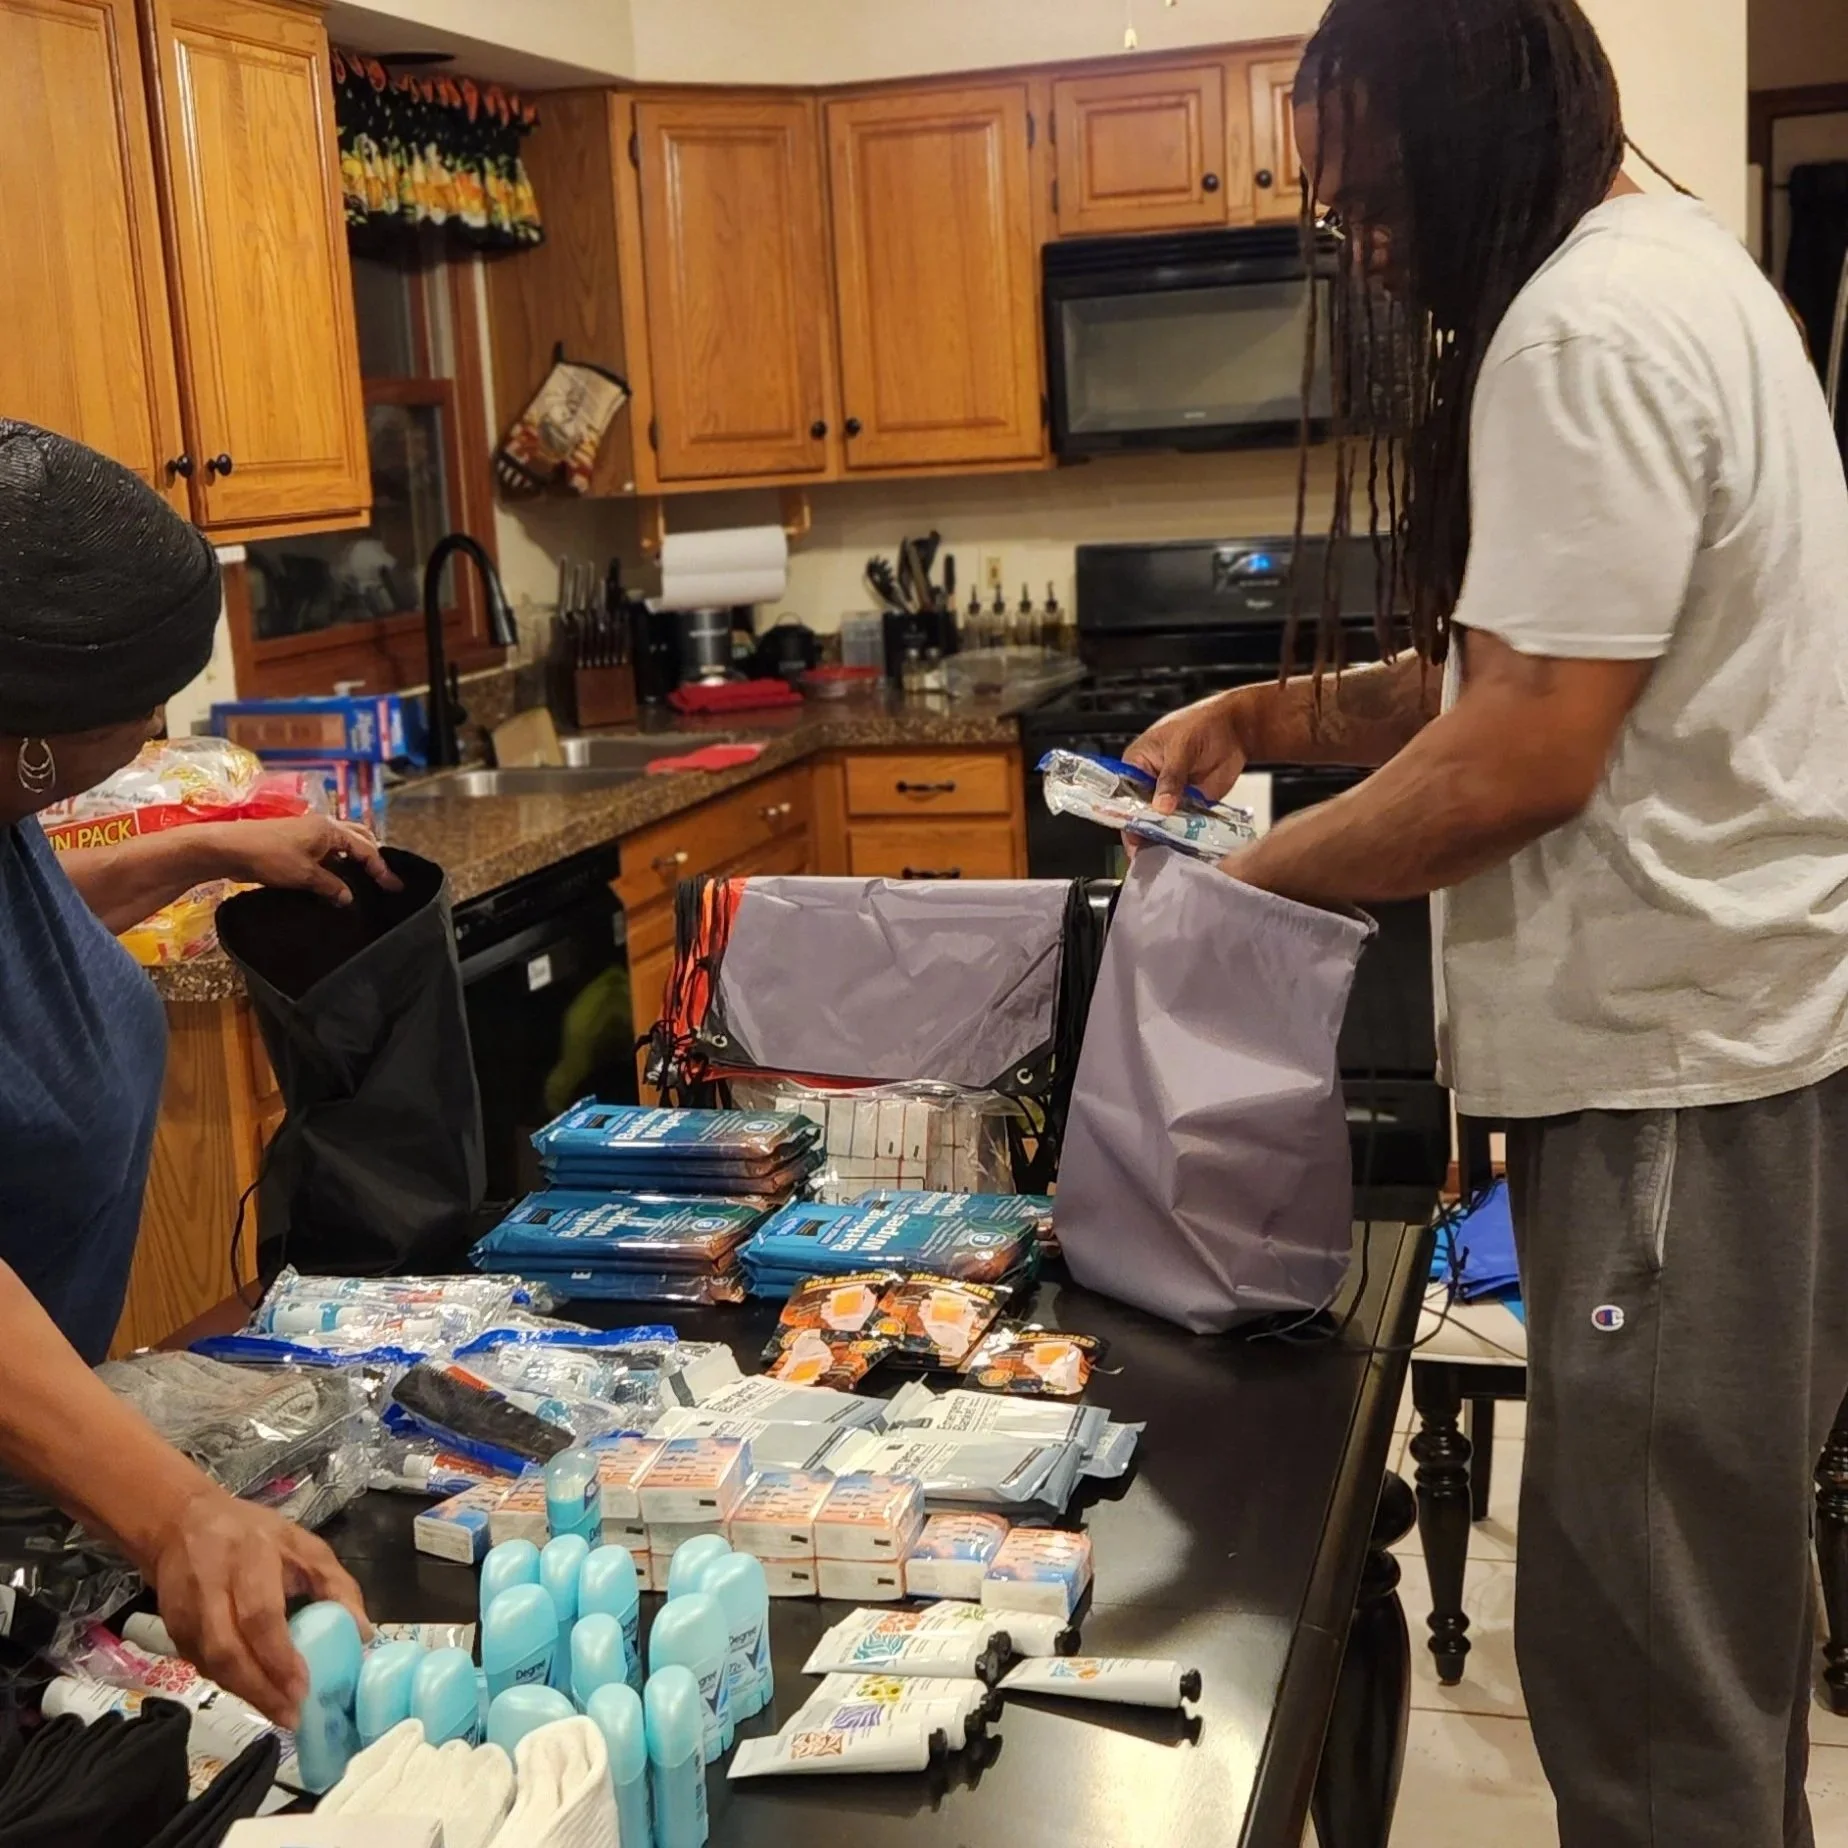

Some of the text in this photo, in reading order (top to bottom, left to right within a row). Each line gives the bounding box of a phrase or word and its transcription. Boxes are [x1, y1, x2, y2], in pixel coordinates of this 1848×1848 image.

[78, 818, 133, 849] PACK
[557, 1203, 622, 1238] Bathing
[584, 1206, 640, 1237] Wipes
[829, 1209, 890, 1252] Bathing
[858, 1213, 910, 1251] Wipes
[515, 1657, 546, 1681] Degree
